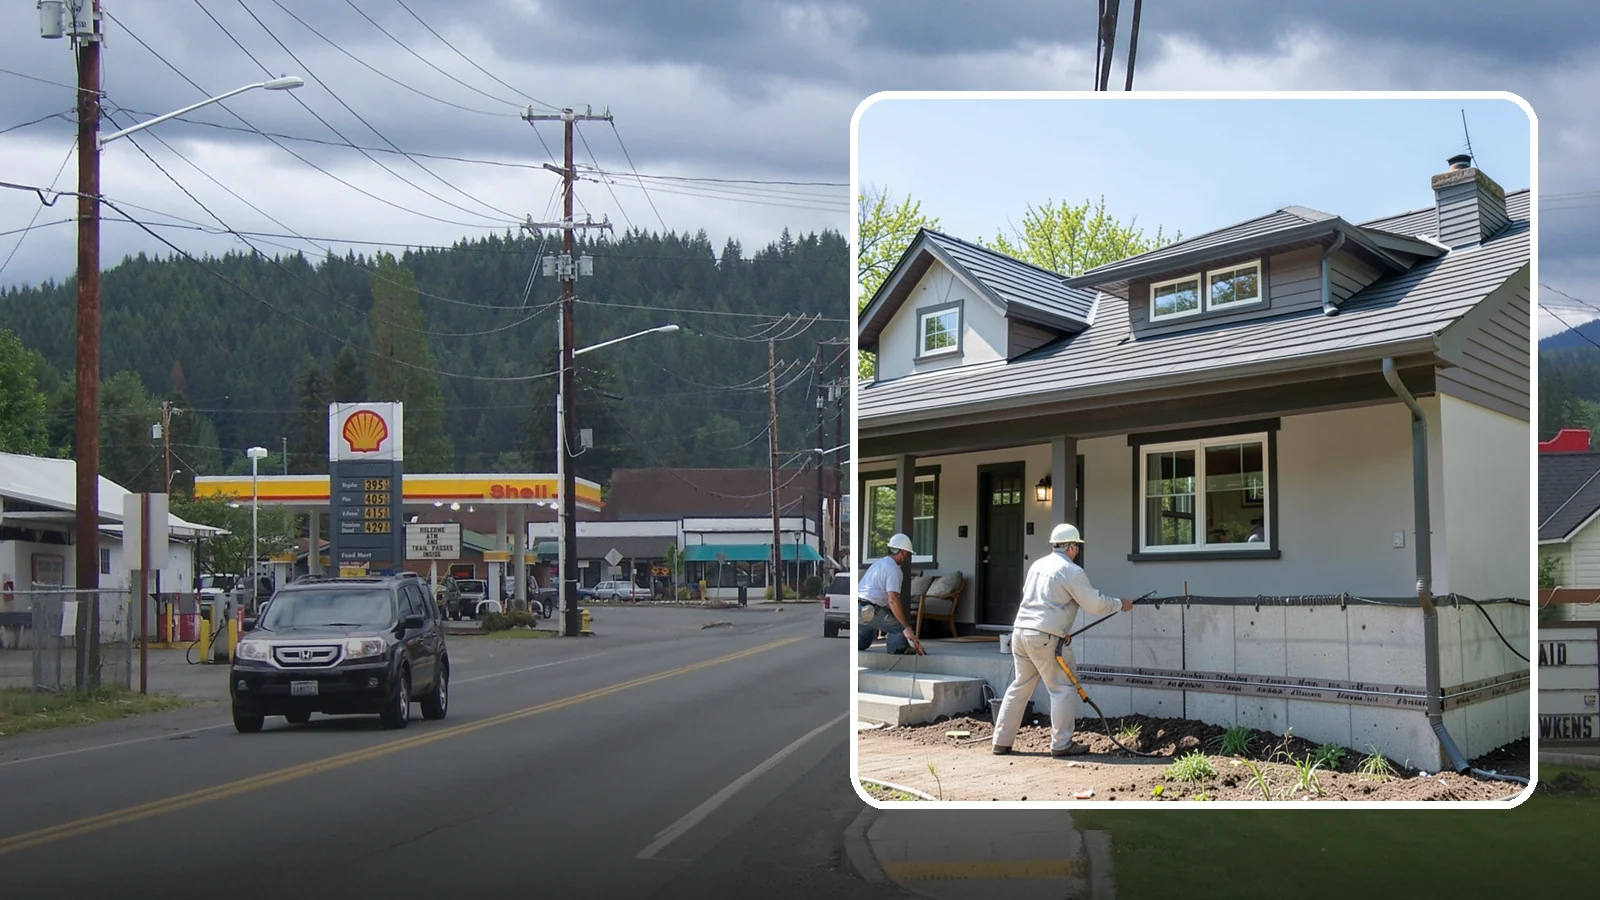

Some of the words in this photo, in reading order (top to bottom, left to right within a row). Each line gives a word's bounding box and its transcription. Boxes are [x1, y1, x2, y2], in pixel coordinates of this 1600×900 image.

[366, 480, 384, 490] 395
[490, 484, 547, 499] Shell
[366, 494, 384, 504] 405
[366, 508, 384, 518] 415
[366, 522, 384, 532] 429
[1539, 643, 1566, 665] AID
[1538, 716, 1592, 739] WKENS
